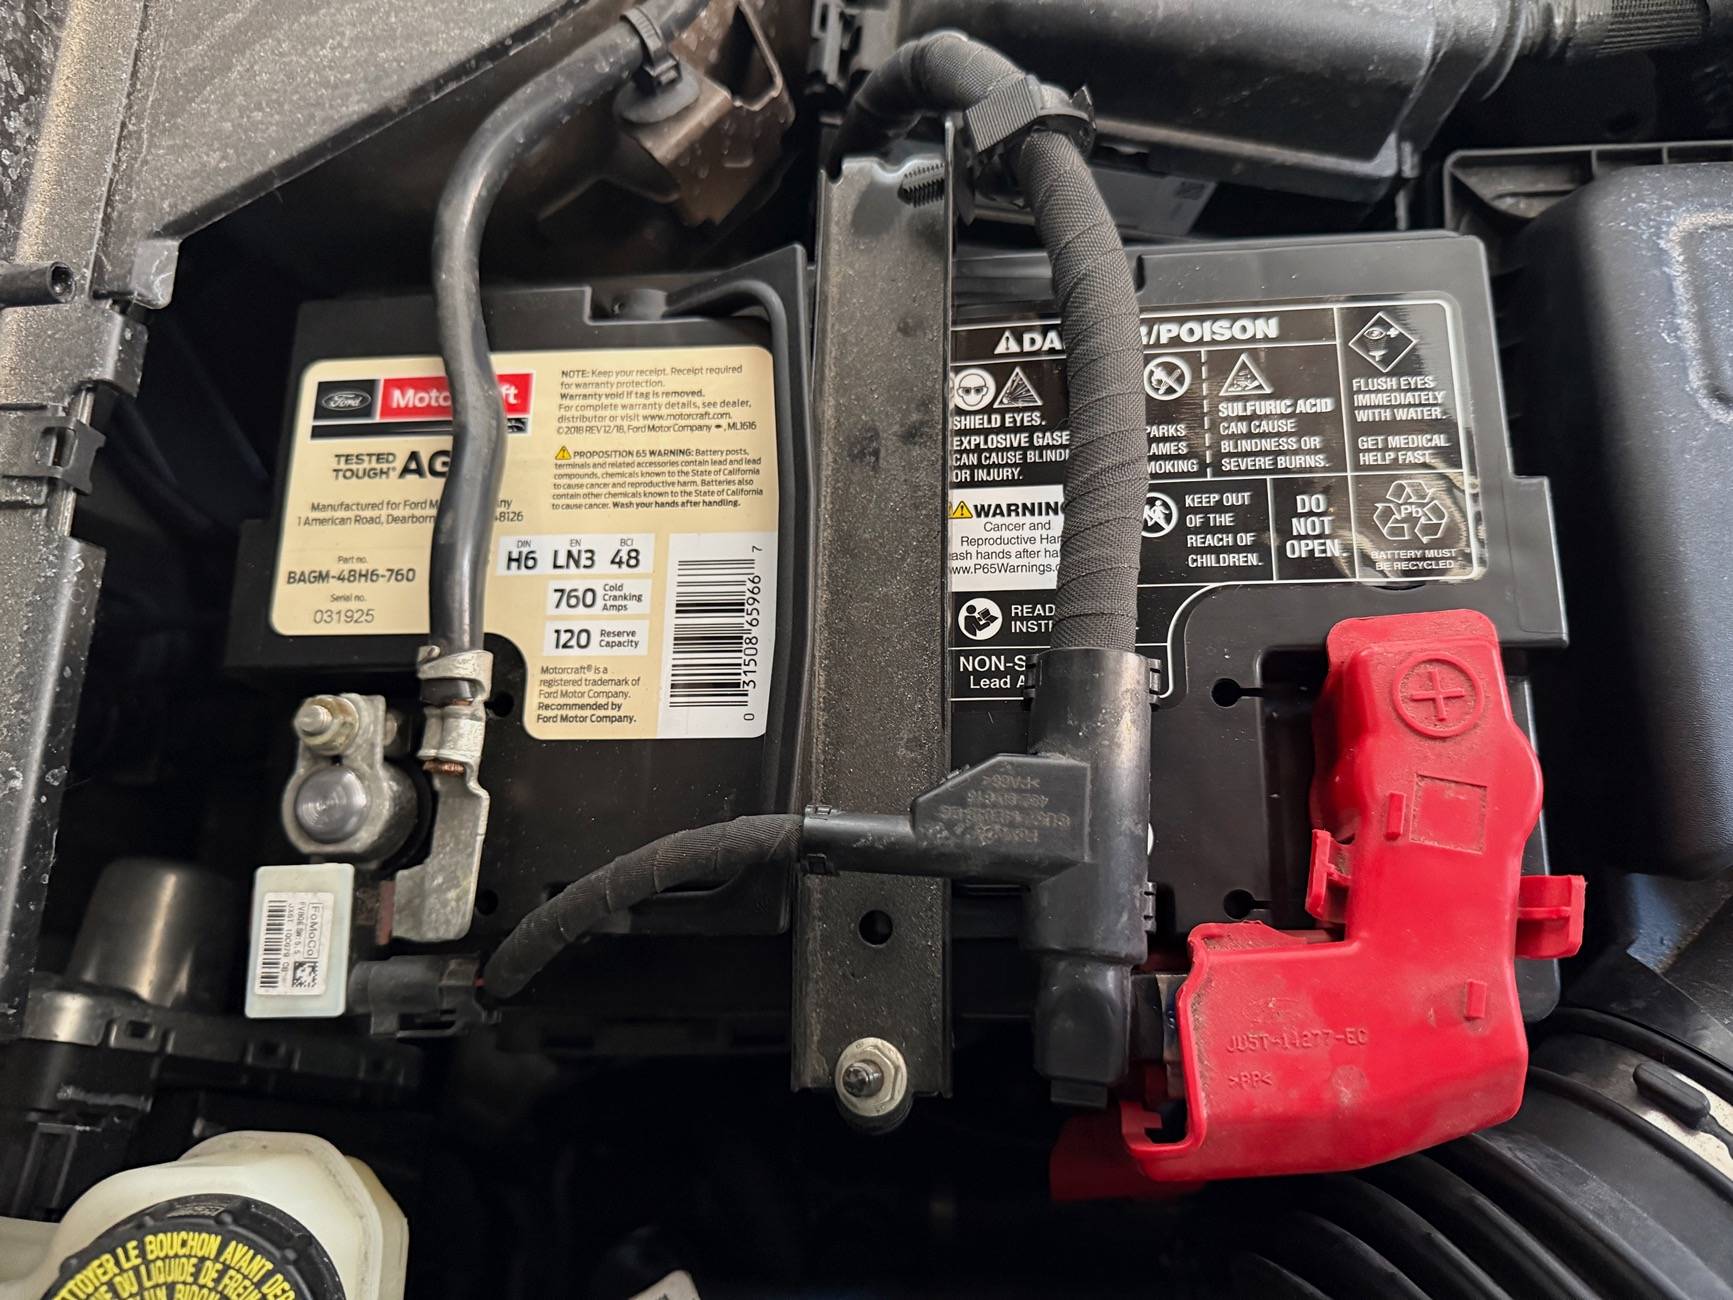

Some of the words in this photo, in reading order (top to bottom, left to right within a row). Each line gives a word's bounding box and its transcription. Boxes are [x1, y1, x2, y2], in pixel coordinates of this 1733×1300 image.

[560, 369, 589, 378] NOTE:
[591, 369, 613, 378] Keep
[614, 369, 634, 378] your
[670, 366, 703, 376] Receipt
[705, 364, 742, 374] required
[560, 380, 573, 390] for
[574, 380, 614, 389] warranty
[615, 378, 664, 388] protection.
[1352, 377, 1398, 390] FLUSH
[325, 392, 362, 408] Ford
[559, 392, 603, 401] Warranty
[604, 390, 624, 399] void
[626, 390, 633, 398] if
[634, 391, 650, 400] tag
[652, 390, 660, 398] is
[661, 388, 704, 398] removed.
[1354, 390, 1445, 406] IMMEDIATELY
[558, 403, 573, 411] For
[575, 402, 618, 411] complete
[620, 401, 662, 411] warranty
[1218, 399, 1294, 416] SULFURIC
[1295, 397, 1334, 413] ACID
[557, 414, 607, 423] distributor
[620, 413, 639, 422] visit
[642, 411, 732, 420] www.motorcraft.com.
[952, 413, 1000, 429] SHIELD
[1004, 411, 1045, 426] EYES.
[1354, 408, 1391, 421] WITH
[627, 424, 646, 433] Ford
[647, 423, 672, 432] Motor
[671, 423, 712, 432] Company
[1219, 421, 1248, 434] CAN
[1250, 418, 1295, 433] CAUSE
[953, 433, 1029, 449] EXPLOSIVE
[1033, 431, 1070, 446] GASE
[1220, 437, 1298, 452] BLINDNESS
[1300, 436, 1320, 449] OR
[1358, 435, 1385, 449] GET
[1387, 434, 1451, 447] MEDICAL
[334, 452, 396, 464] TESTED
[573, 449, 634, 458] PROPOSITION
[635, 449, 646, 457] 65
[648, 448, 694, 457] WARNING:
[694, 448, 724, 456] Battery
[952, 452, 977, 466] CAN
[981, 450, 1022, 464] CAUSE
[1359, 451, 1396, 464] HELP
[1221, 456, 1274, 470] SEVERE
[1277, 454, 1328, 468] BURNS.
[952, 468, 970, 482] OR
[974, 467, 1022, 480] INJURY.
[310, 500, 384, 512] Manufactured
[385, 499, 402, 510] for
[402, 498, 427, 510] Ford
[612, 500, 634, 508] Wash
[635, 501, 653, 509] your
[654, 499, 679, 507] hands
[680, 499, 701, 507] after
[702, 498, 740, 507] handling.
[1185, 493, 1220, 506] KEEP
[1222, 492, 1250, 505] OUT
[1296, 494, 1326, 512] DO
[1400, 504, 1423, 518] Pb
[303, 516, 352, 526] American
[353, 513, 383, 525] Road,
[983, 521, 1025, 532] Cancer
[1028, 519, 1050, 530] and
[1186, 514, 1204, 527] OF
[1206, 512, 1234, 526] THE
[1291, 516, 1333, 535] NOT
[516, 539, 531, 548] DIN
[569, 538, 581, 547] EN
[619, 537, 633, 546] BCI
[960, 534, 1036, 547] Reproductive
[1039, 532, 1062, 546] Har
[1187, 533, 1233, 546] REACH
[1236, 532, 1255, 545] OF
[752, 545, 763, 553] 7
[950, 549, 972, 560] ash
[975, 548, 1012, 560] hands
[1014, 548, 1040, 558] after
[1370, 549, 1423, 560] BATTERY
[1424, 548, 1456, 557] MUST
[337, 555, 354, 564] Part
[506, 550, 537, 570] H6
[552, 549, 595, 569] LN3
[610, 548, 640, 568] 48
[1188, 552, 1262, 567] CHILDREN.
[1375, 560, 1392, 571] BE
[1393, 560, 1456, 570] RECYCLED
[287, 568, 415, 584] BAGM-48H6-760
[602, 583, 623, 592] Cold
[330, 593, 352, 602] Serial
[553, 587, 596, 608] 760
[602, 592, 642, 604] Cranking
[746, 574, 761, 628] 65966
[602, 602, 628, 612] Amps
[1011, 604, 1055, 616] READ
[313, 608, 375, 623] 031925
[554, 628, 590, 648] 120
[600, 628, 636, 637] Reserve
[598, 638, 639, 648] Capacity
[742, 635, 759, 690] 31508
[593, 665, 600, 674] is
[601, 666, 608, 674] a
[539, 676, 582, 688] registered
[584, 676, 630, 686] trademark
[630, 676, 640, 686] of
[970, 674, 1010, 688] Lead
[538, 688, 558, 698] Ford
[559, 689, 586, 698] Motor
[587, 688, 631, 699] Company.
[537, 701, 609, 710] Recommended
[610, 700, 622, 712] by
[536, 713, 558, 723] Ford
[559, 713, 588, 723] Motor
[589, 713, 636, 724] Company.
[743, 713, 755, 721] 0
[306, 905, 320, 957] FoMoCo
[116, 1240, 142, 1270] LE
[144, 1231, 222, 1260] BOUCHON
[219, 1240, 274, 1283] AVANT
[112, 1270, 138, 1299] DU
[140, 1257, 198, 1288] LIQUIDE
[198, 1260, 223, 1288] DE
